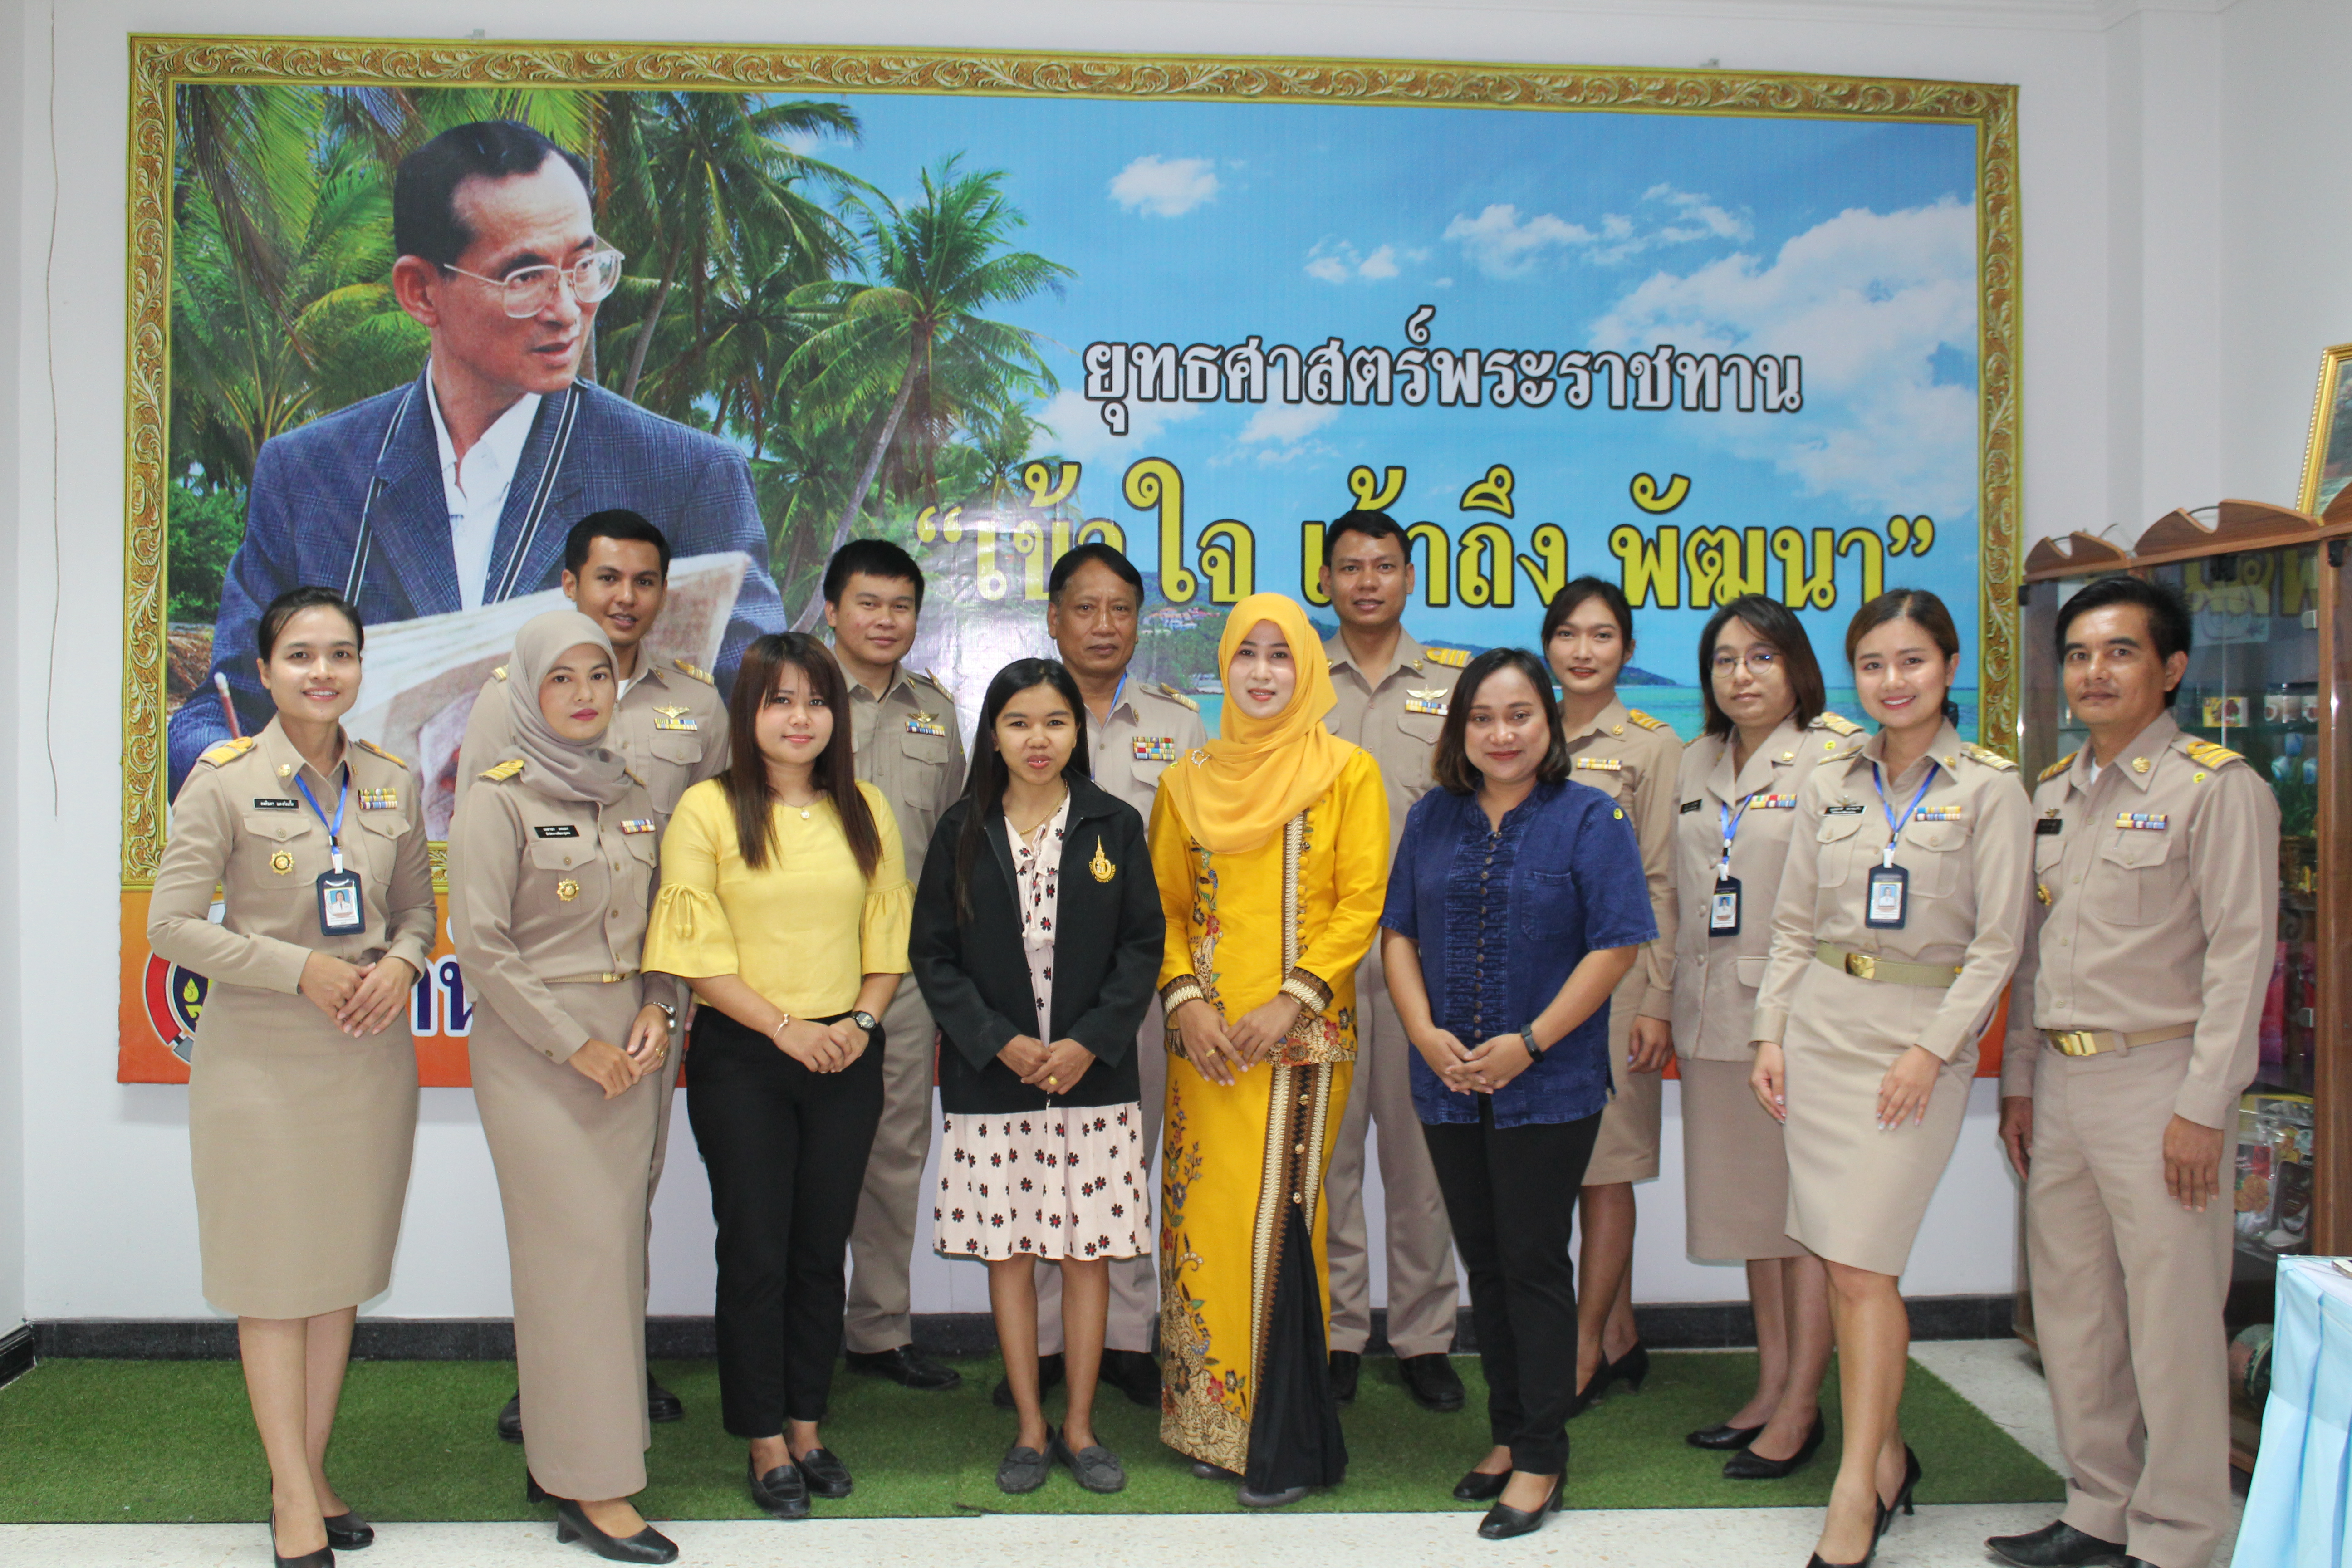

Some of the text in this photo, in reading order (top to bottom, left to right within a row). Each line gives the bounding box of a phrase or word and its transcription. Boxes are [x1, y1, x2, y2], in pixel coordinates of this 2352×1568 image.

[1083, 305, 1803, 436] ยุทธศาสตร์พระราชทาน
[1301, 463, 1568, 608] เ้าถึง
[1608, 472, 1935, 611] พัฒนา”
